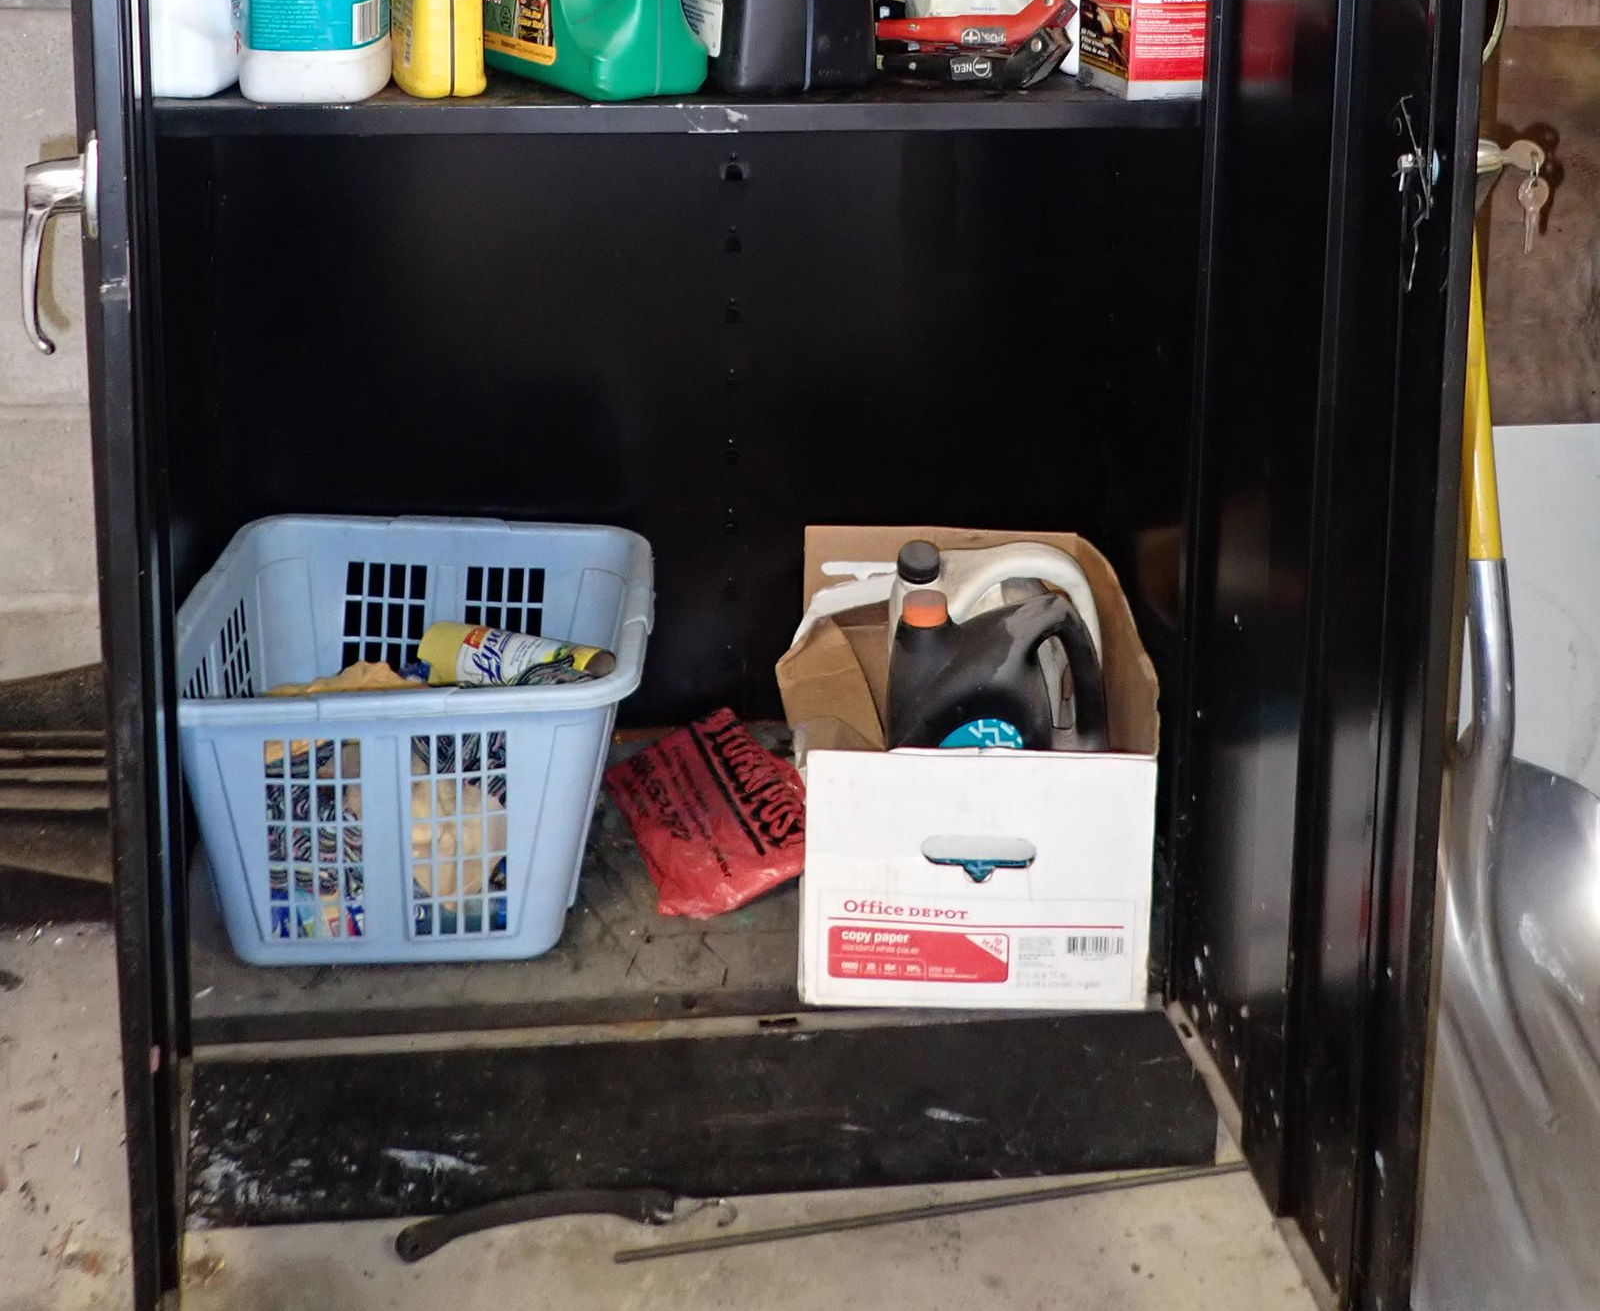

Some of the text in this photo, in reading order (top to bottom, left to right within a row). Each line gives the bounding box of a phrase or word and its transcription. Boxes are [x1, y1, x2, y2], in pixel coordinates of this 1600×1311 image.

[843, 899, 969, 920] Office DEPOT
[841, 930, 910, 945] copy paper
